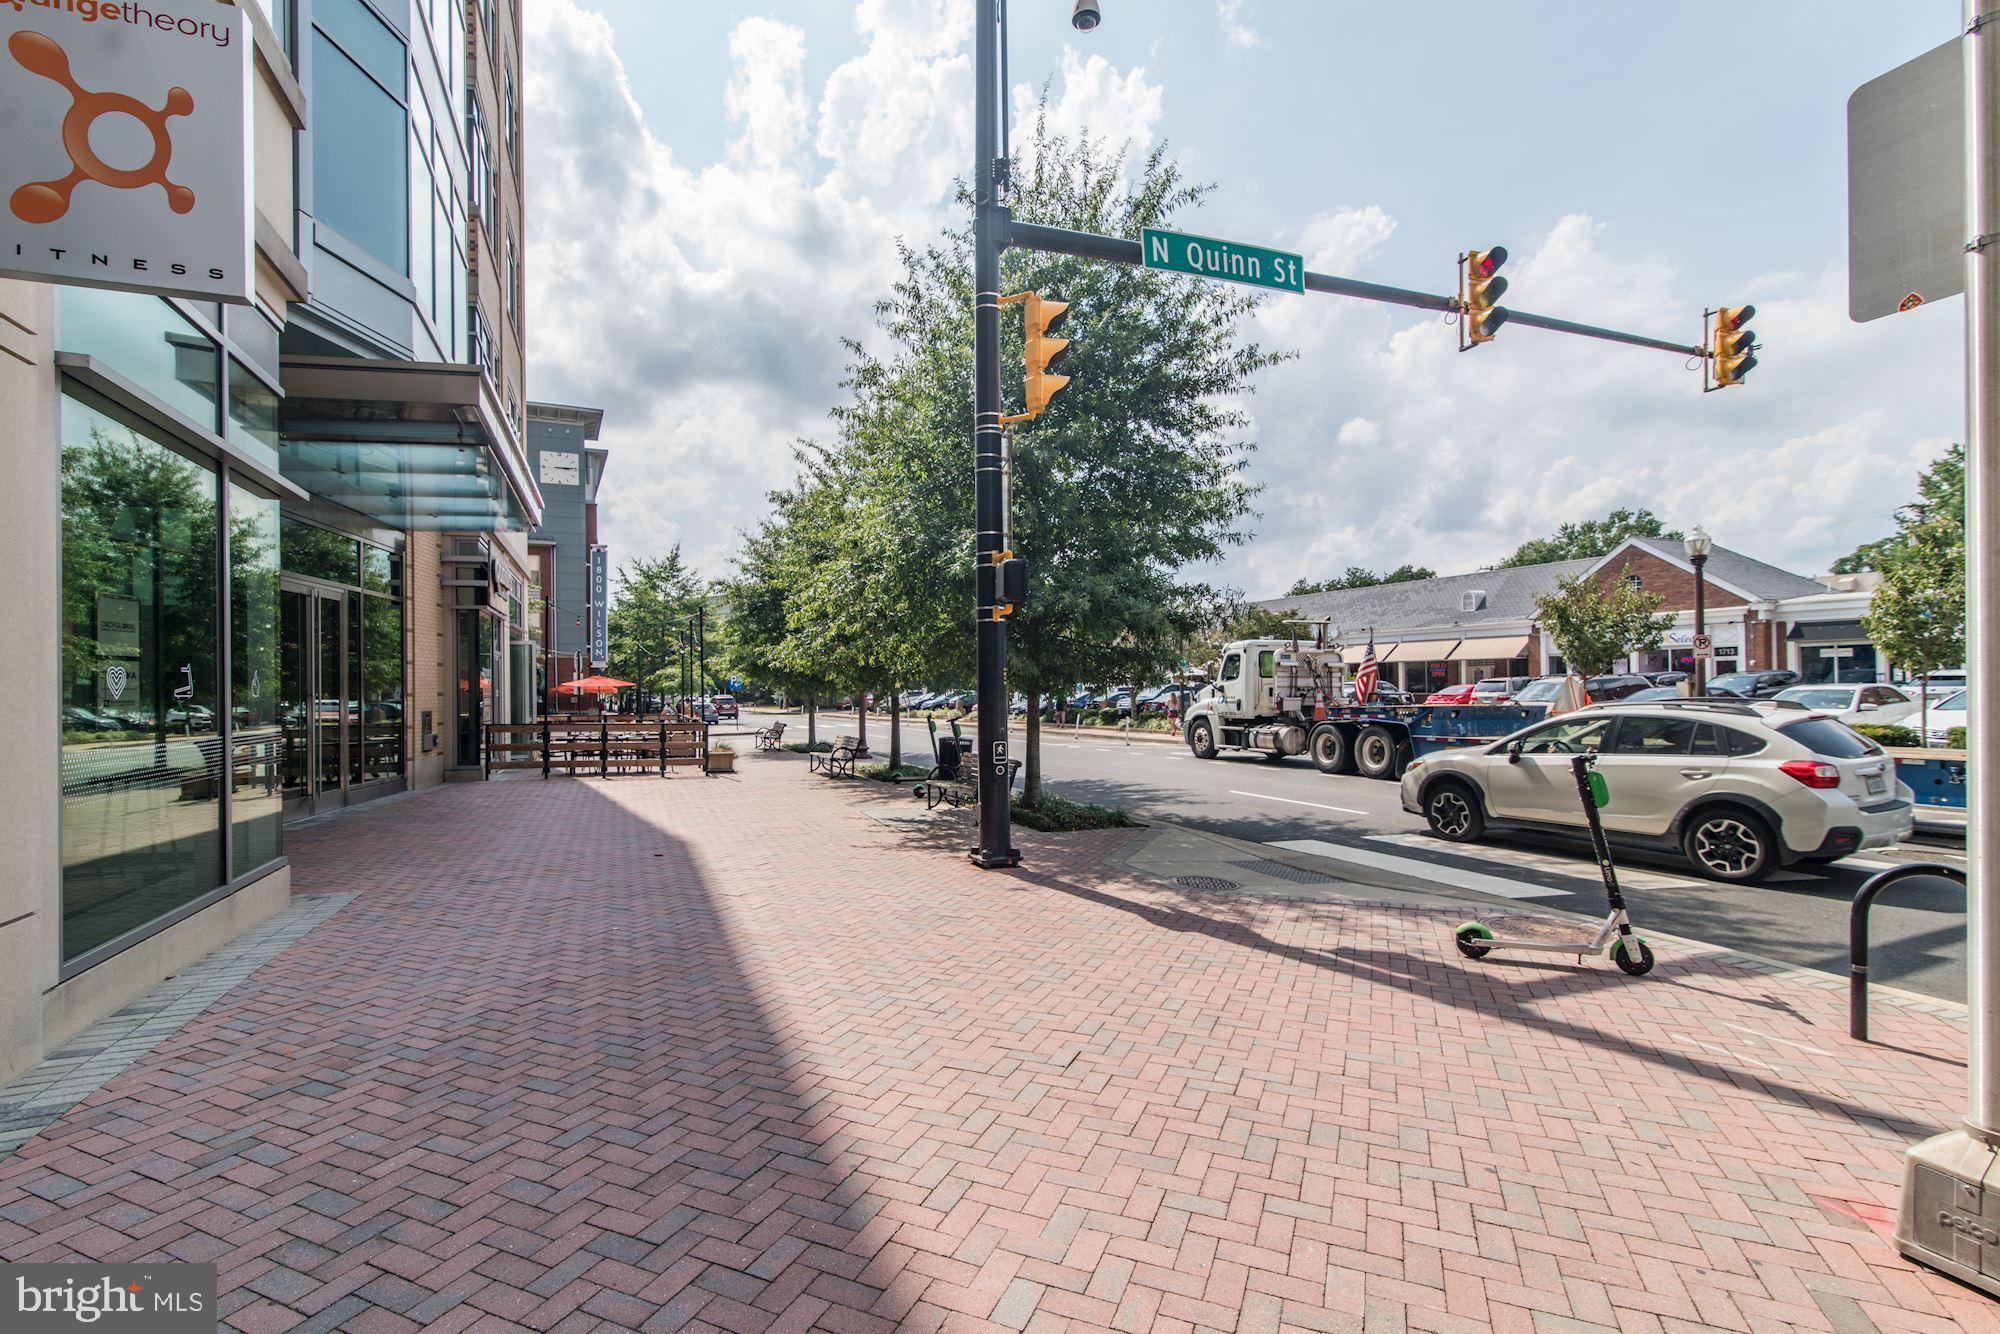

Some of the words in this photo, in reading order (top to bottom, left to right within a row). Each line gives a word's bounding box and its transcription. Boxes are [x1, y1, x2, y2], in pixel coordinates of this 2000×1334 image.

[15, 244, 224, 280] ITNESS
[1152, 236, 1169, 263] N
[1186, 242, 1261, 279] Quinn
[1273, 258, 1297, 286] St
[595, 556, 603, 594] 1800
[594, 601, 604, 657] WILSON
[1668, 632, 1694, 644] Selec
[1718, 648, 1735, 656] 1713
